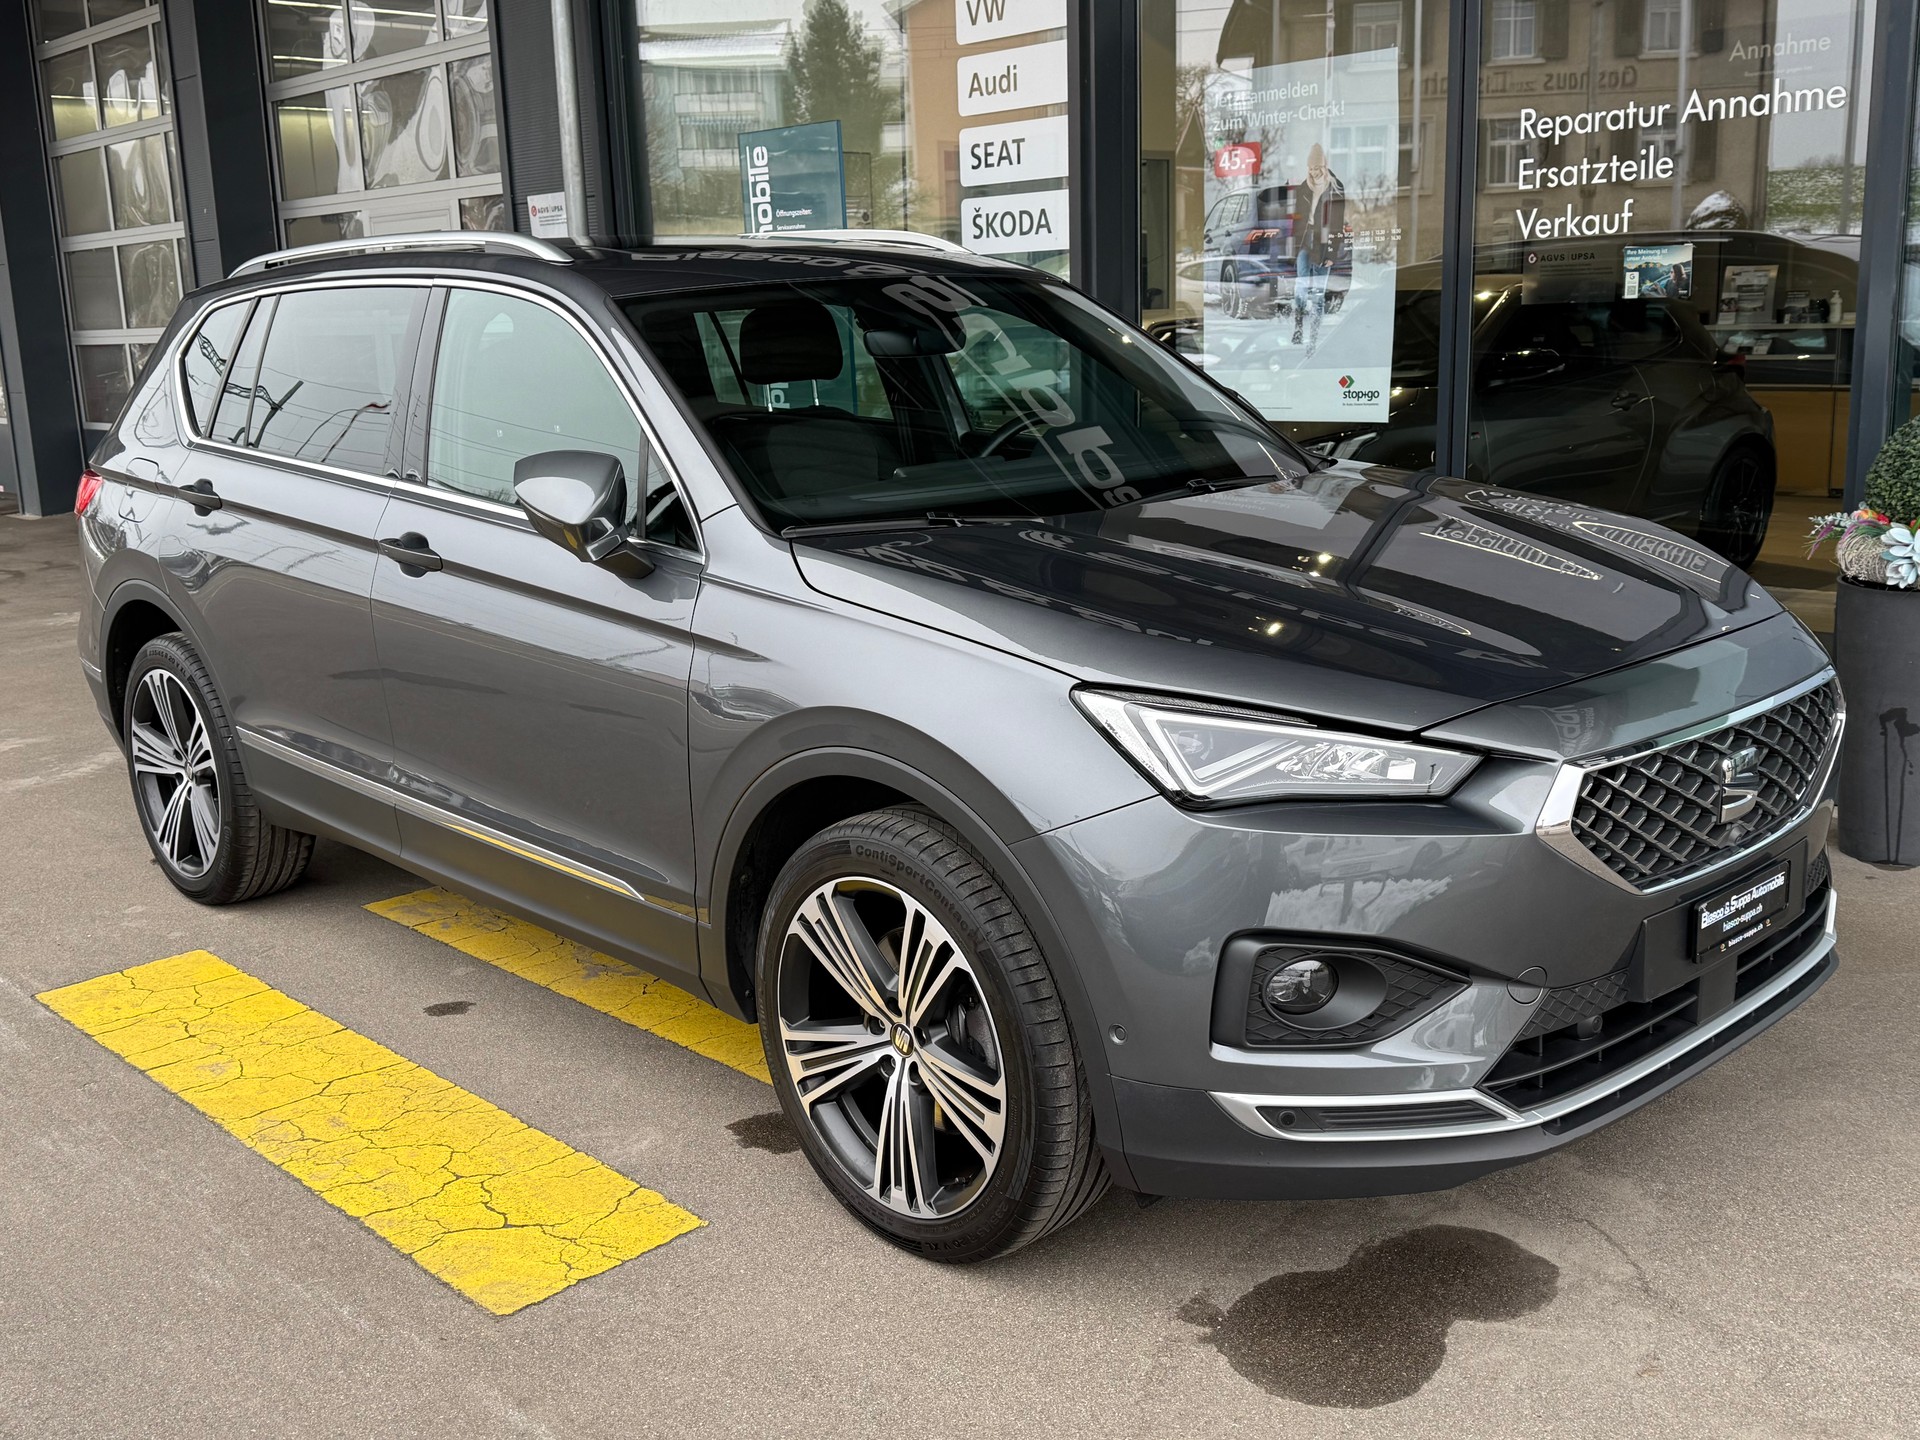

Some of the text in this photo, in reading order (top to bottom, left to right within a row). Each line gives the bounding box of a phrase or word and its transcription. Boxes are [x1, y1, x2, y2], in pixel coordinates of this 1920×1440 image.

[966, 0, 1005, 26] VW
[1728, 32, 1832, 62] Annahme
[968, 64, 1018, 99] Audi
[1250, 81, 1319, 103] anmelden
[1213, 100, 1345, 132] zum Winter-Check!
[1519, 78, 1847, 145] Reparatur Annahme
[970, 138, 1026, 170] SEAT
[1518, 145, 1674, 190] Ersatzteile
[972, 207, 1053, 240] ŠKODA
[1516, 199, 1635, 240] Verkauf
[1540, 252, 1595, 262] AGVS UPSA
[1343, 389, 1380, 402] stop+go
[1701, 908, 1724, 929] Biasco
[1731, 894, 1752, 911] Suppa
[1751, 874, 1785, 900] Automobile
[1723, 903, 1763, 932] biasco-suppa.ch
